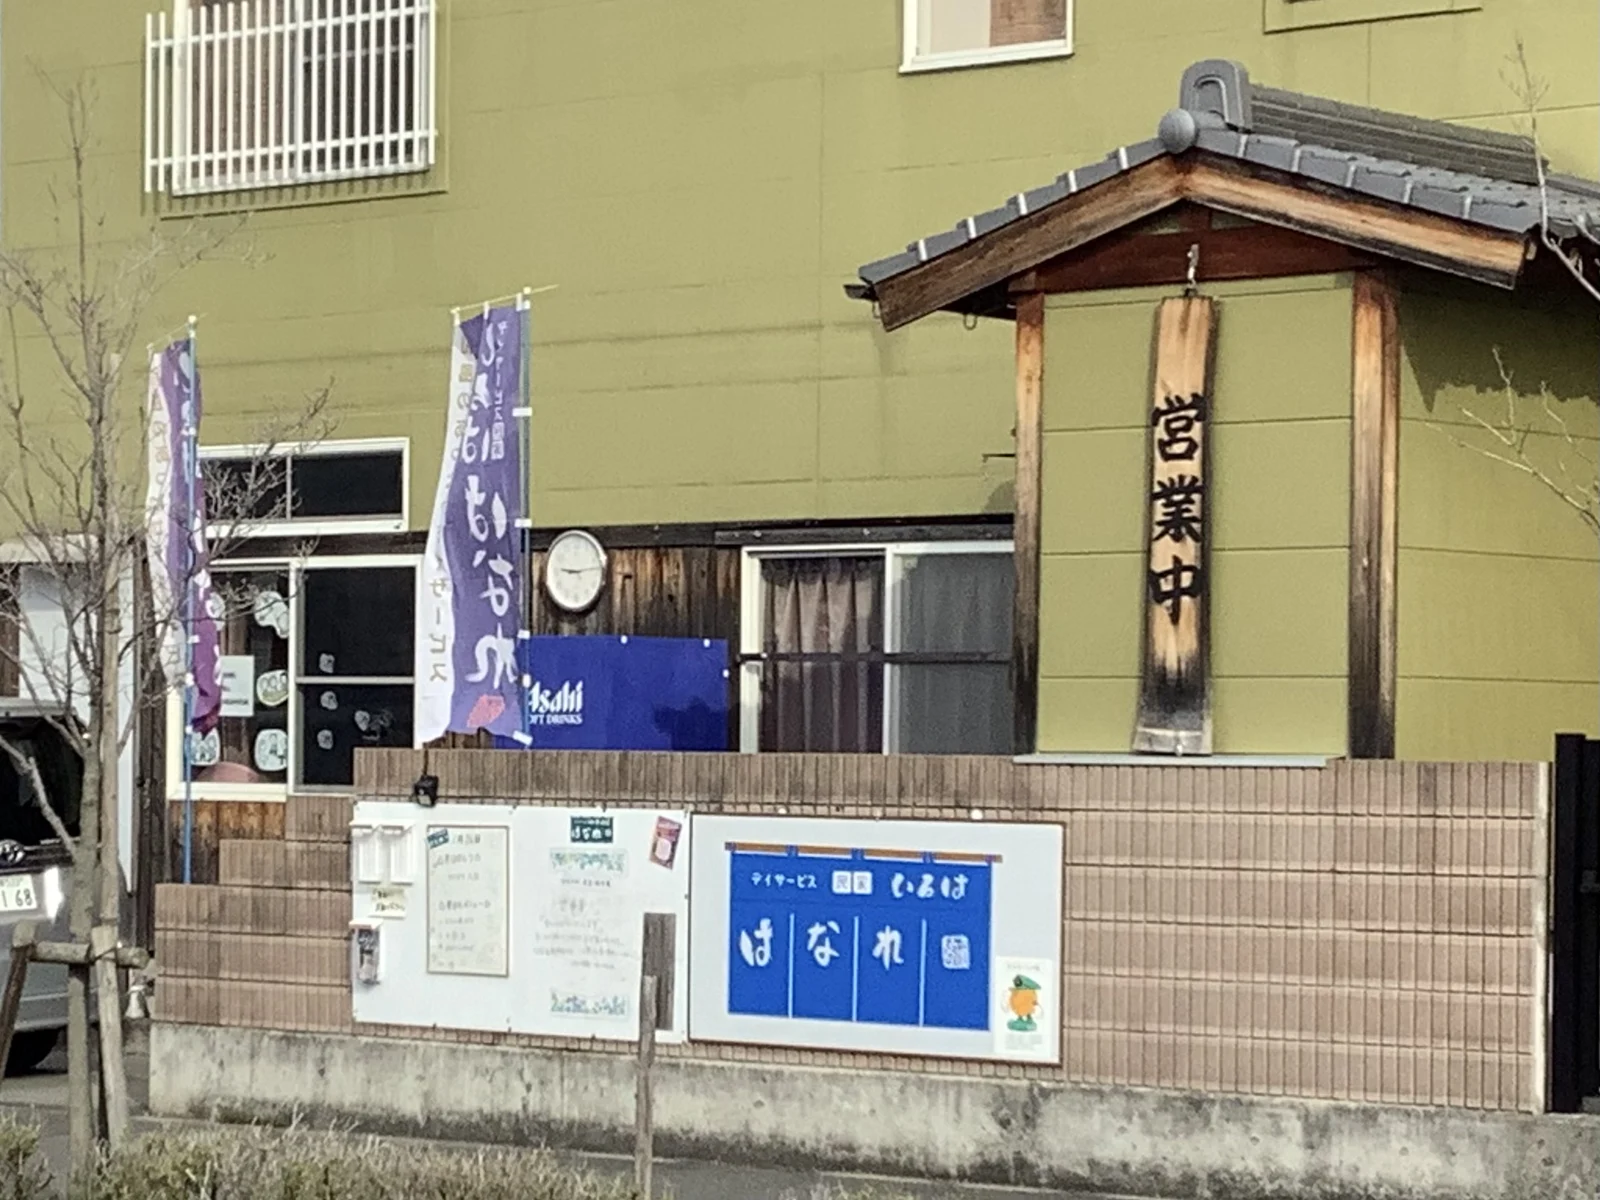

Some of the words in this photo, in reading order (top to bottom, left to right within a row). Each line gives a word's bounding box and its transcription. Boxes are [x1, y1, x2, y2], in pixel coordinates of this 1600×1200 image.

[1149, 392, 1203, 627] 営業中
[528, 680, 583, 713] Asahi
[546, 714, 583, 725] DRINKS
[752, 872, 818, 889] デイサービス
[739, 918, 904, 970] はなれ
